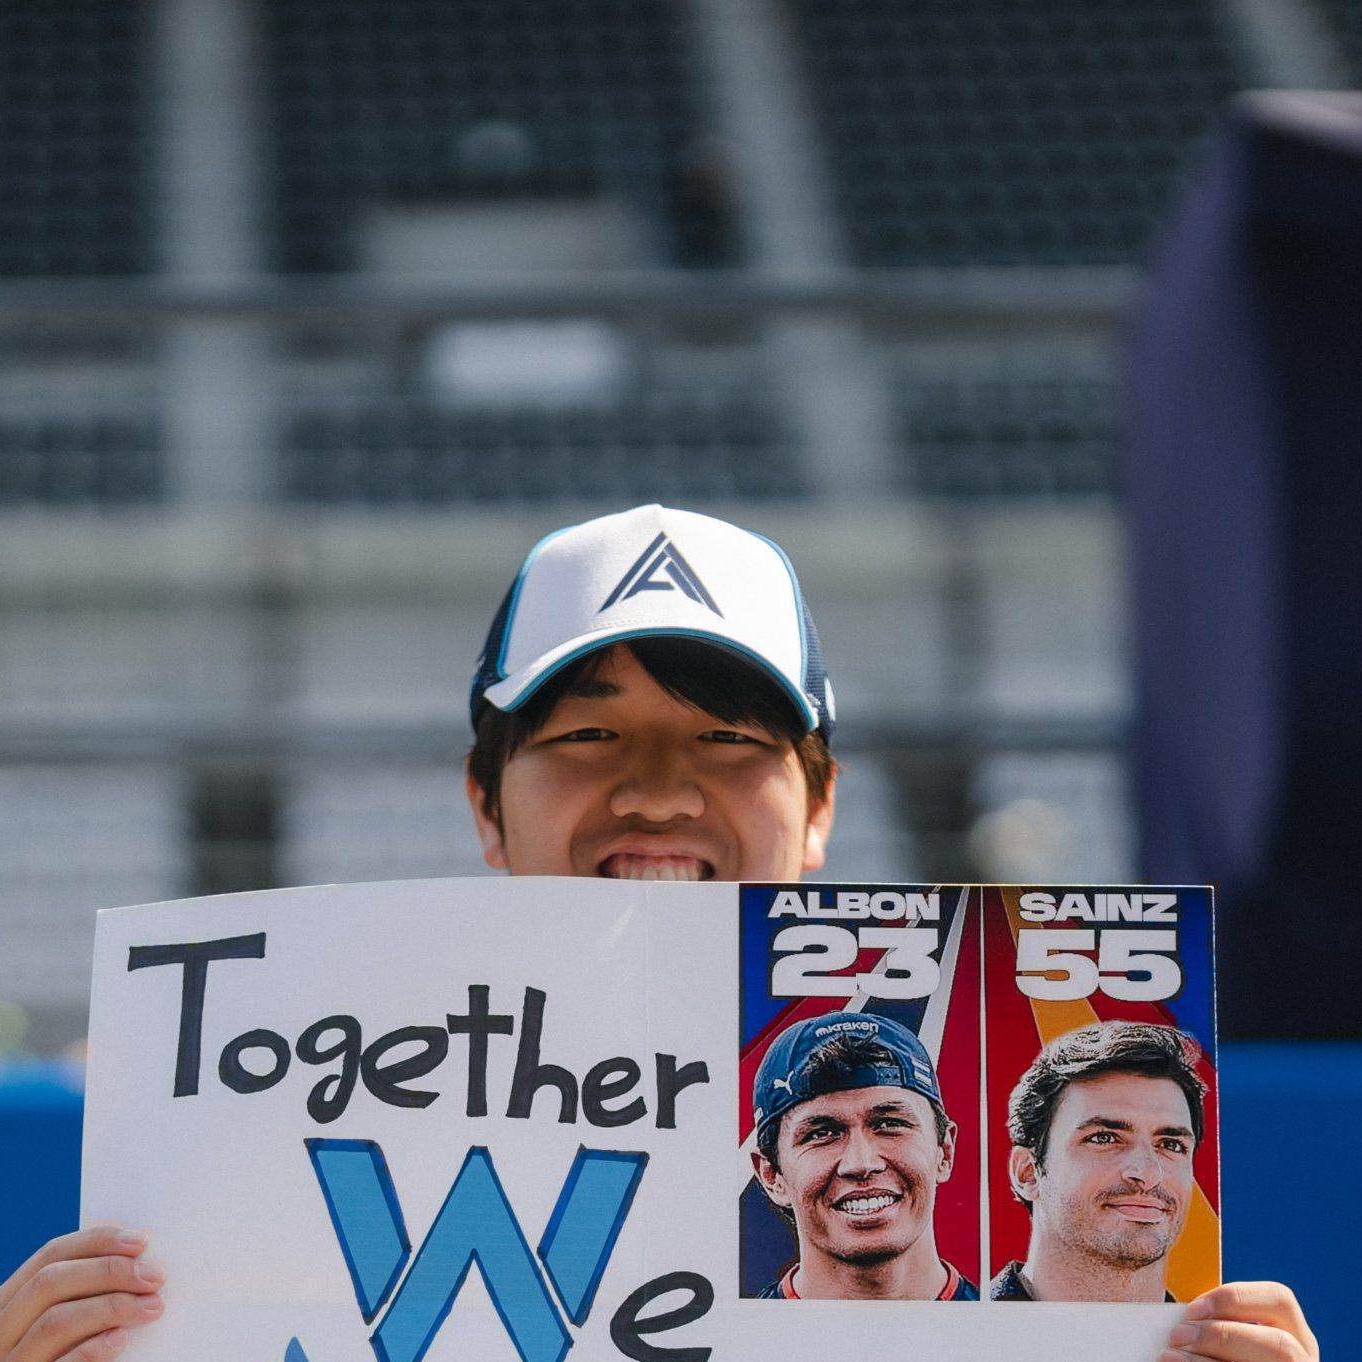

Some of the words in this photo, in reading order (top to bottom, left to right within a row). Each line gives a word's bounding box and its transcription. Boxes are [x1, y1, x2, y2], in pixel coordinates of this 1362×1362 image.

[768, 891, 940, 921] ALBON
[1020, 894, 1178, 923] SAINZ
[771, 924, 941, 1001] 23
[1015, 928, 1183, 1003] 55
[127, 931, 711, 1129] Together
[828, 1021, 880, 1034] kraken
